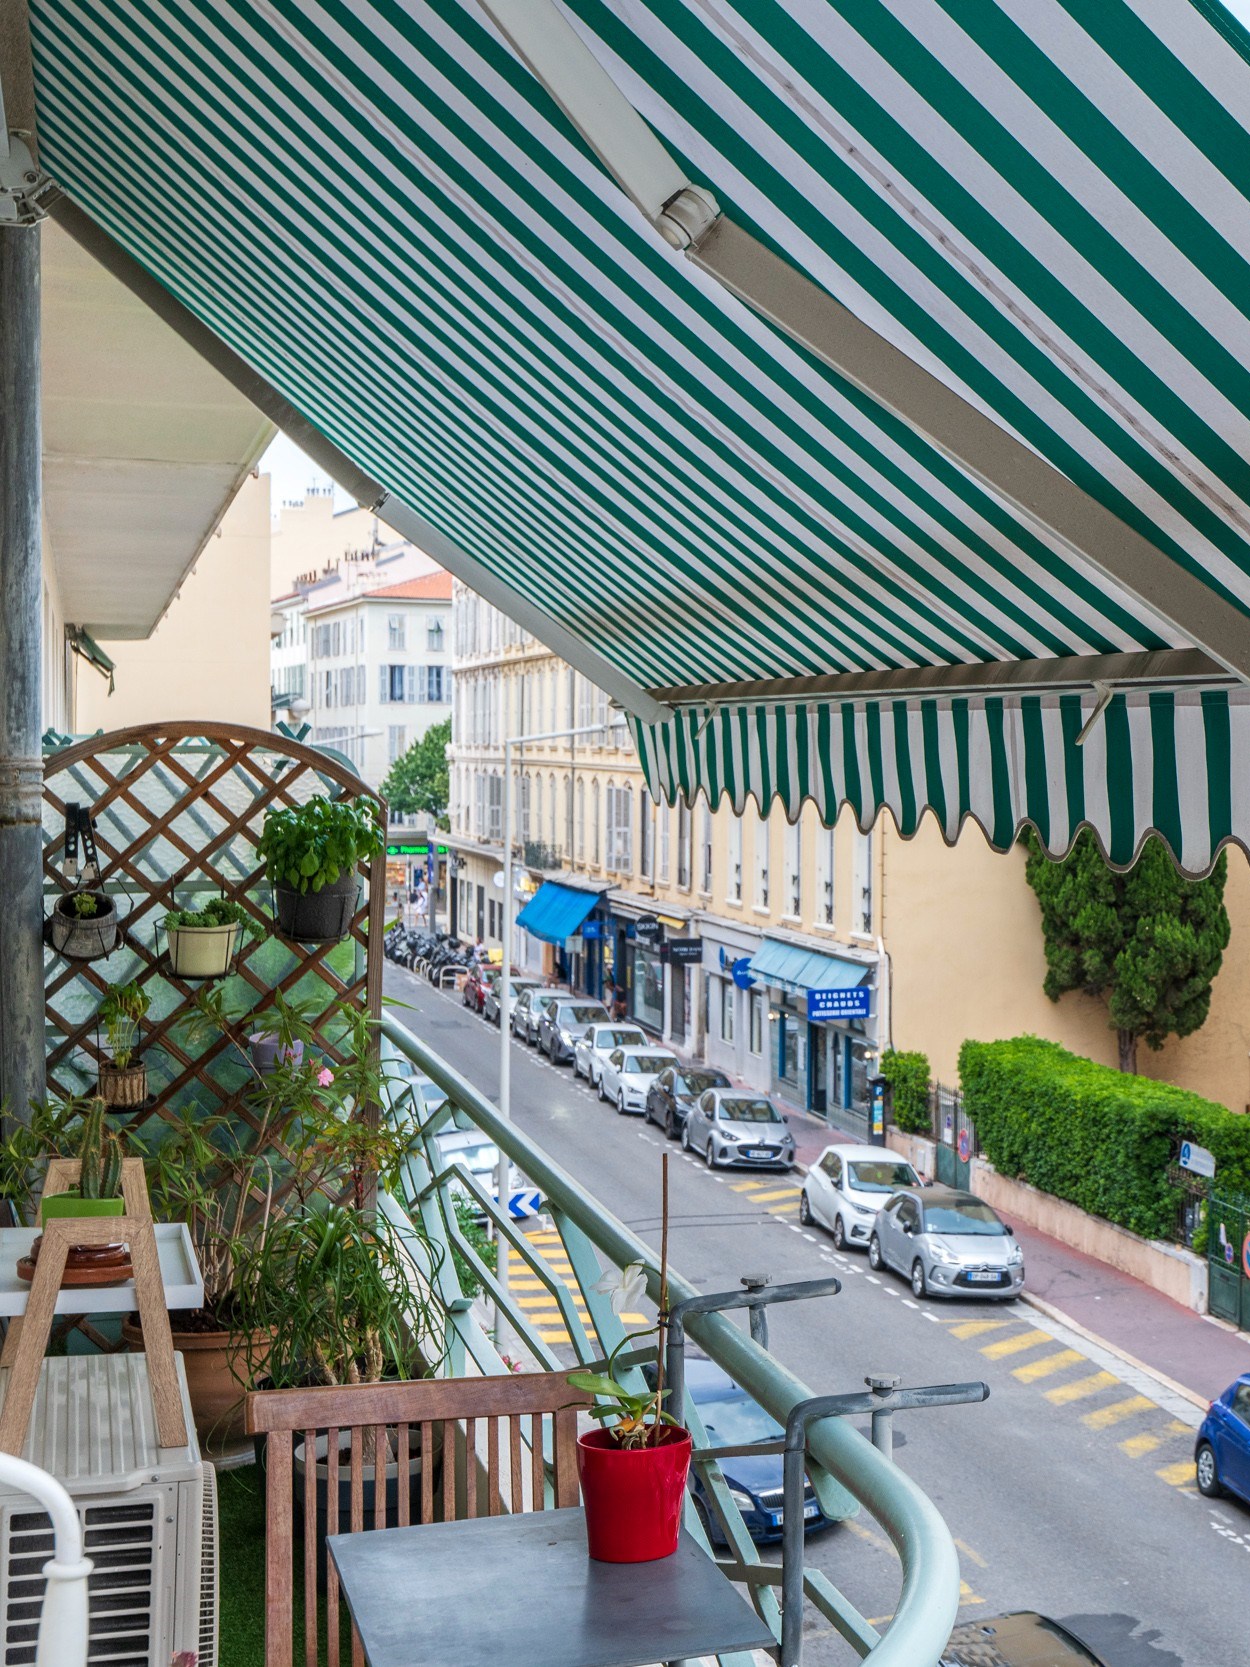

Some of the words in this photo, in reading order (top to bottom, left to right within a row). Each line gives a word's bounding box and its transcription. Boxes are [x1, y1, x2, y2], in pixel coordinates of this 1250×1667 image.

[400, 845, 429, 854] Pharmac
[815, 991, 865, 1000] BEIGNETS
[819, 1000, 860, 1008] CHAUDS
[876, 1086, 882, 1095] P
